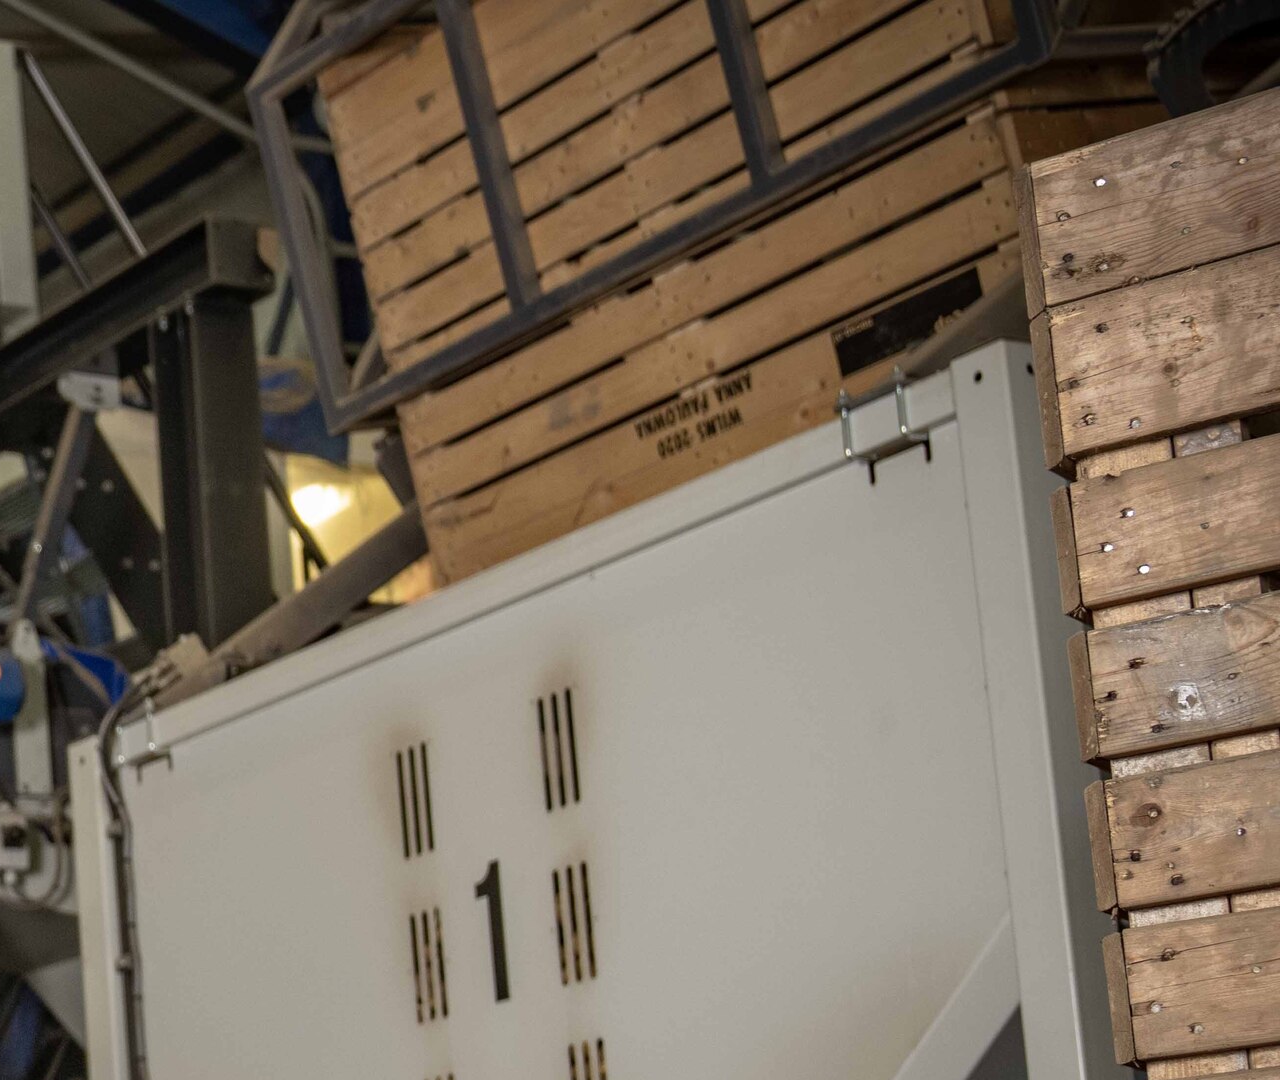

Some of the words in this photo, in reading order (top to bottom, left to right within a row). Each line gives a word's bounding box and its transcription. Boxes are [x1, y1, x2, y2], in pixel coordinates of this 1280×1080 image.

[715, 369, 753, 403] ANNA
[633, 391, 710, 440] PAULOWNA
[698, 407, 745, 443] WILMS
[656, 428, 693, 460] 2020
[474, 859, 510, 1003] 1
